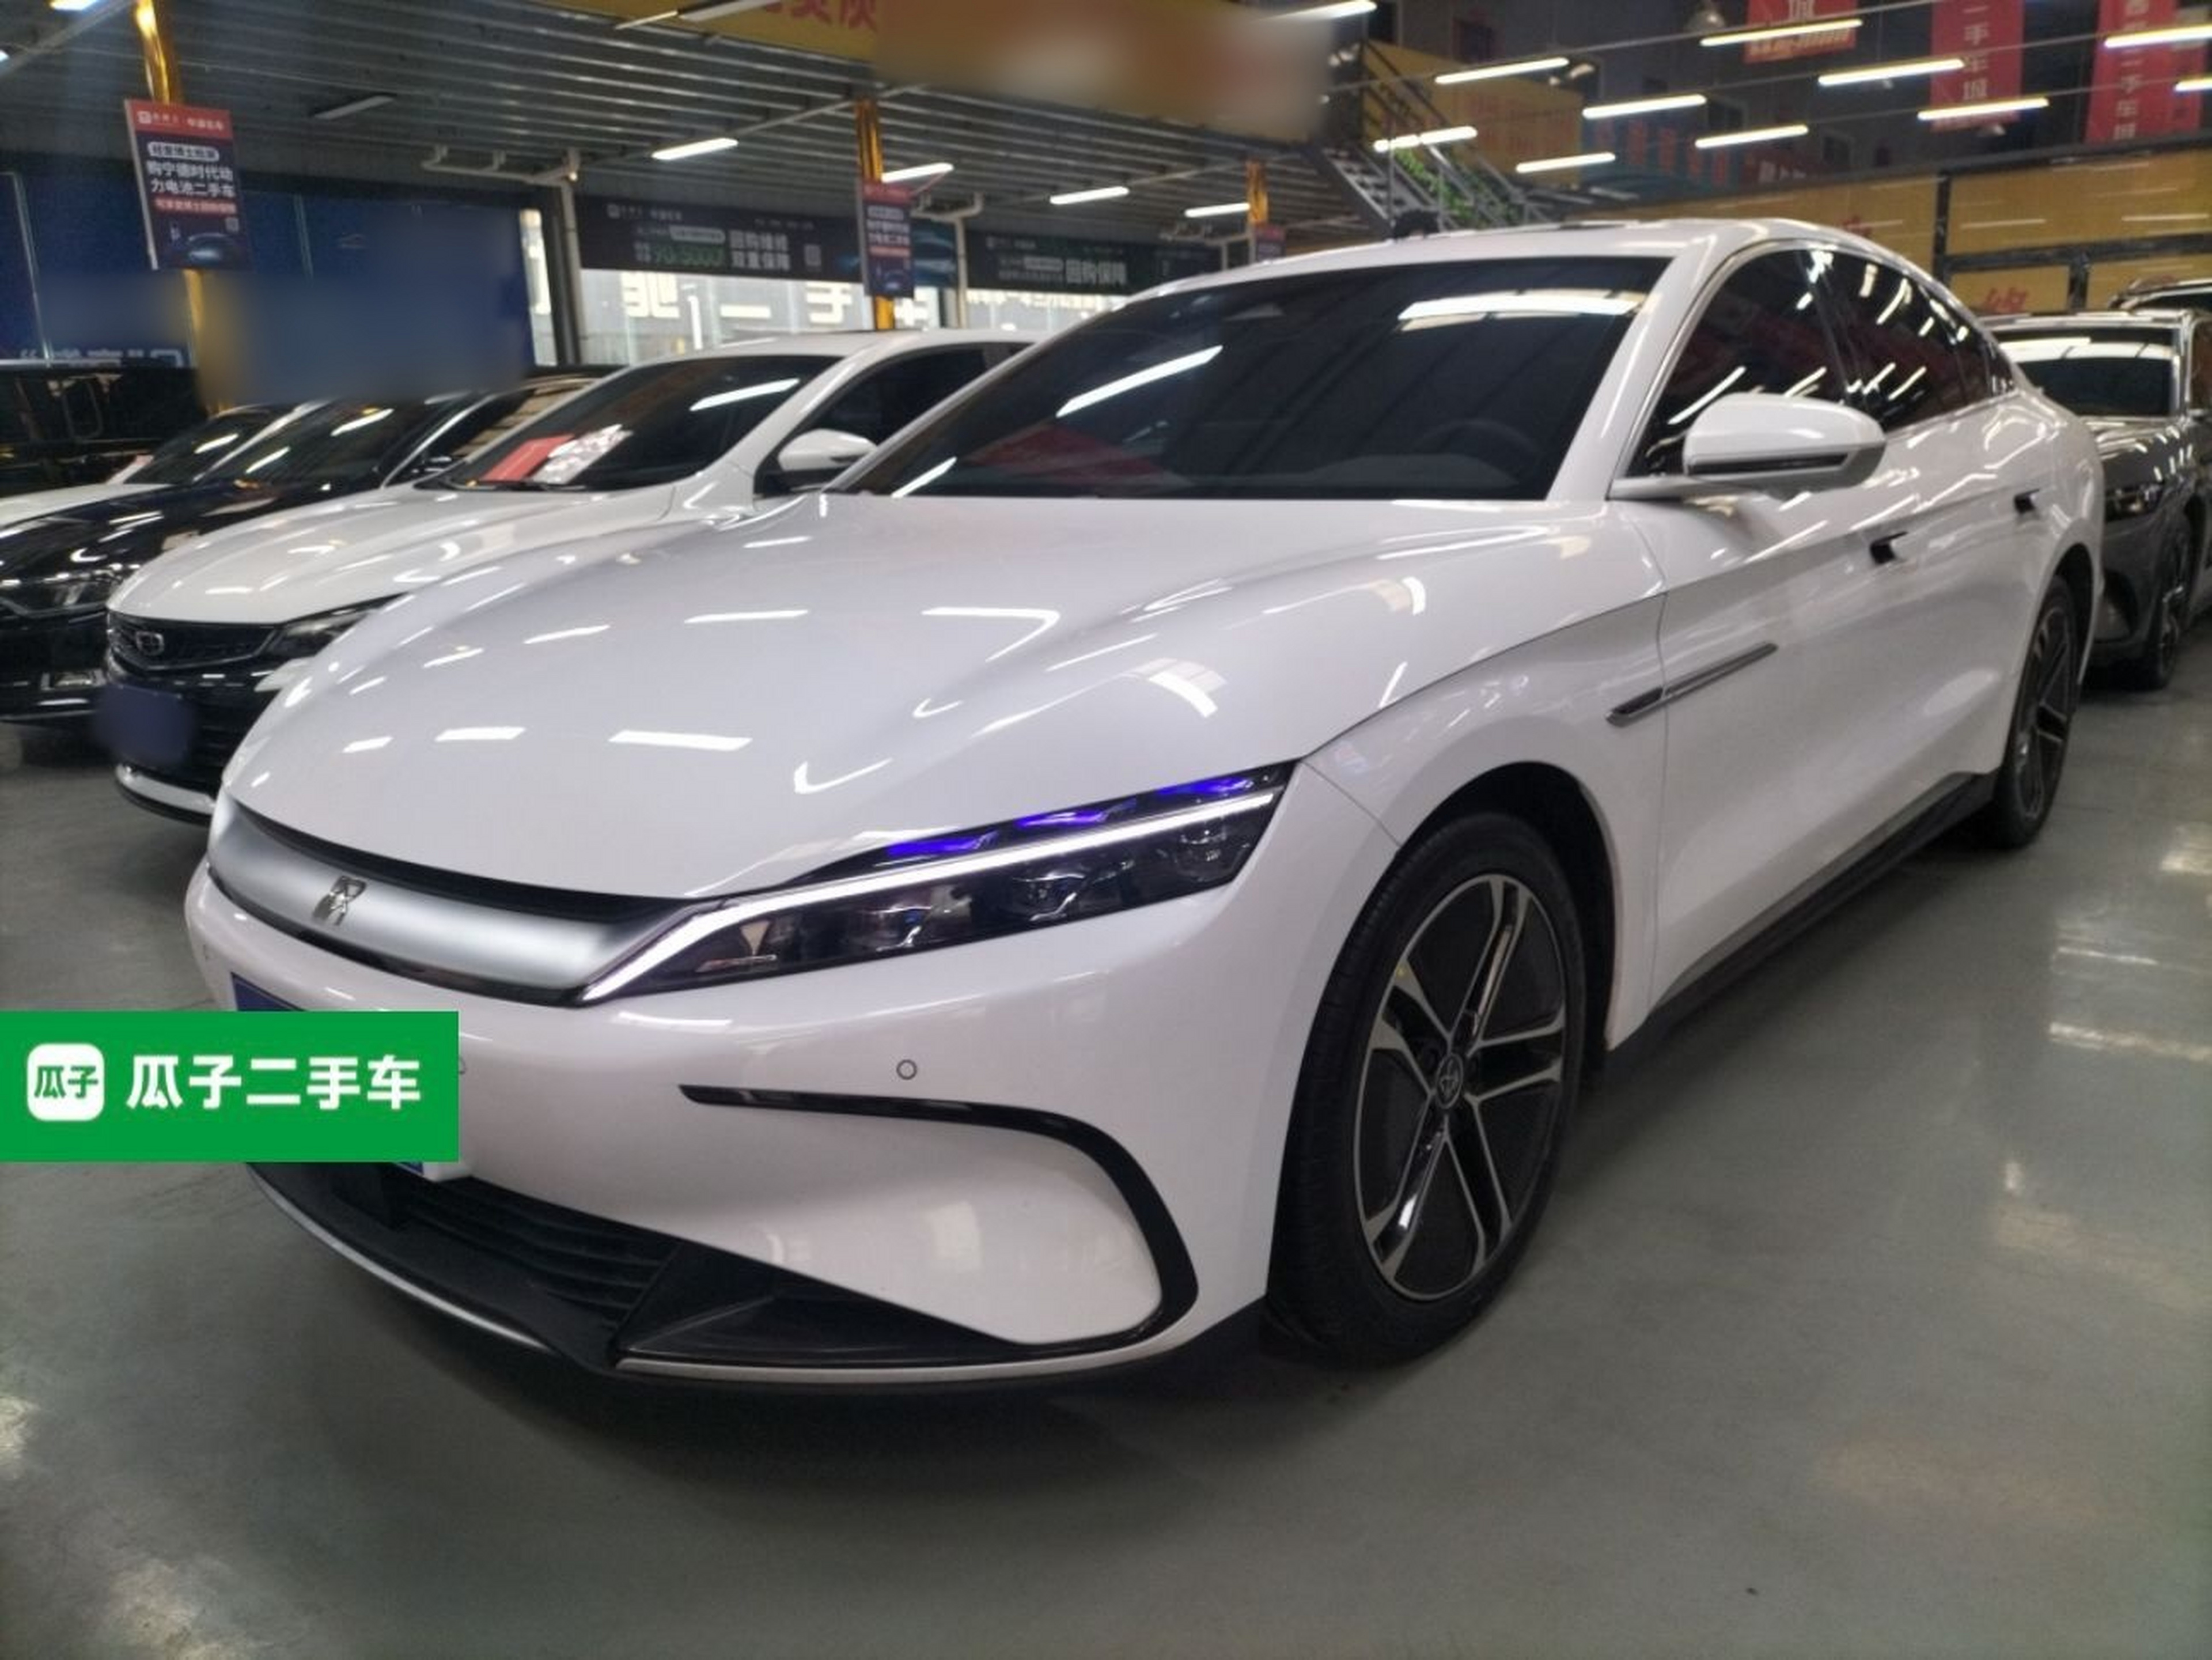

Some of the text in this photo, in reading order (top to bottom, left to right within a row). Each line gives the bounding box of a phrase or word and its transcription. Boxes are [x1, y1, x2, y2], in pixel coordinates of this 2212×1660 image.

[150, 177, 236, 198] 力电池二手车
